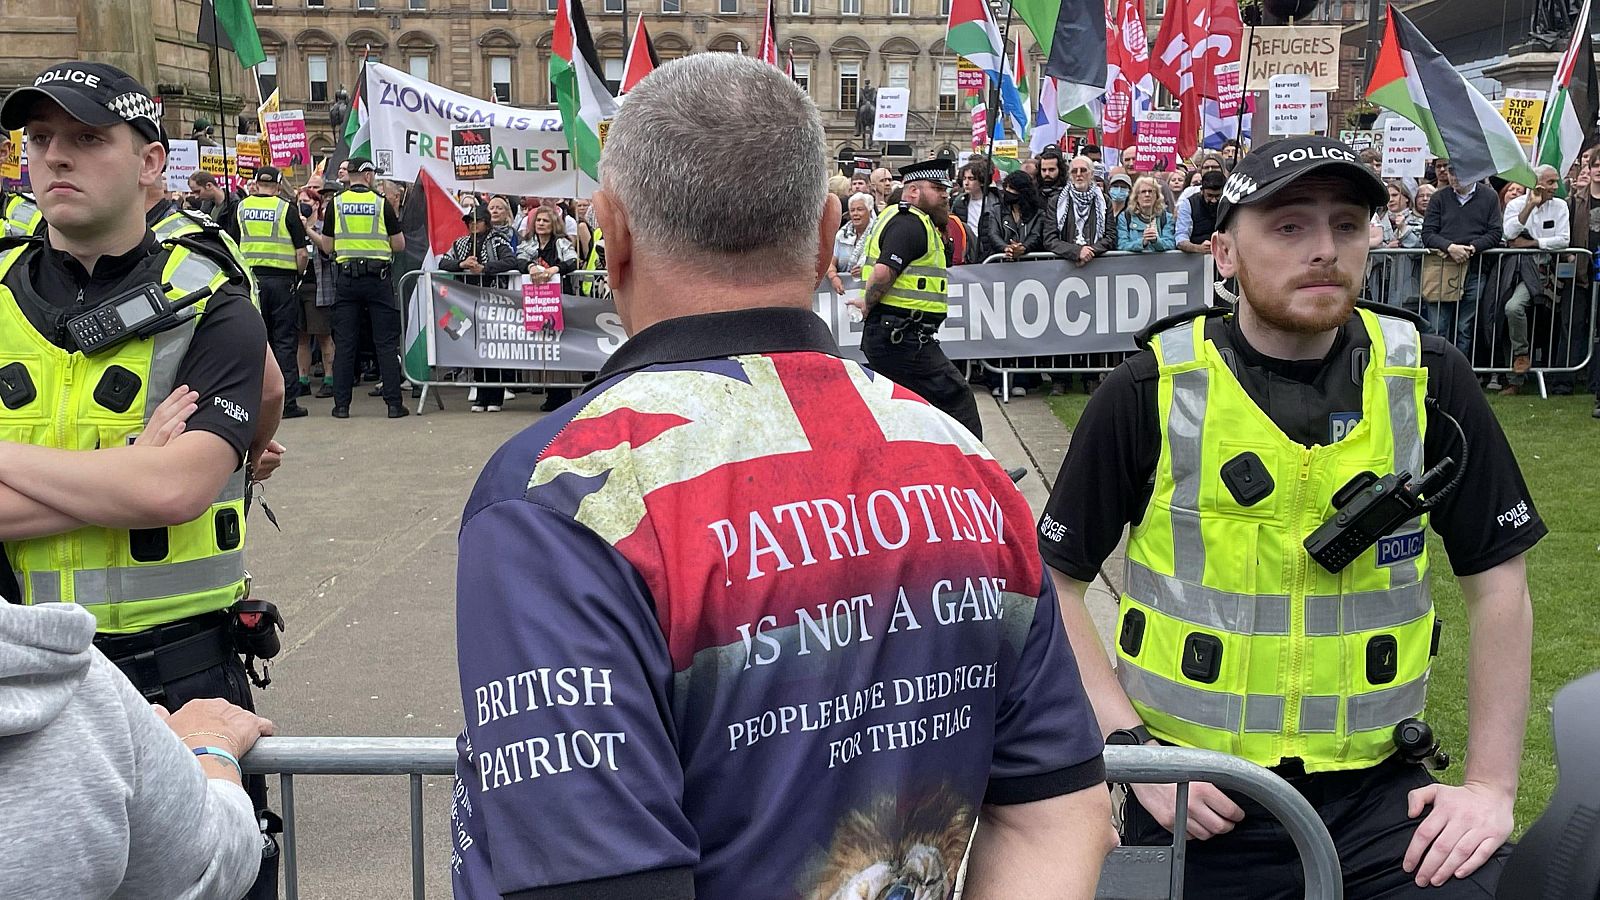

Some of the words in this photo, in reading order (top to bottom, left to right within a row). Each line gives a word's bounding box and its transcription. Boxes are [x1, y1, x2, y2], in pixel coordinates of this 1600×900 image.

[1252, 35, 1335, 56] REFUGEES
[1252, 60, 1328, 80] WELCOME
[34, 69, 101, 89] POLICE
[379, 79, 495, 127] ZIONISM
[1219, 101, 1238, 110] here
[1509, 99, 1535, 108] STOP
[1508, 108, 1526, 117] THE
[505, 115, 532, 131] IS
[1506, 117, 1523, 126] FAR
[269, 132, 306, 142] Refugees
[1511, 127, 1534, 136] IGHT
[271, 141, 305, 150] welcome
[405, 130, 453, 161] FRE
[1138, 134, 1177, 145] Refugees
[272, 150, 292, 159] here
[454, 144, 491, 155] REFUGEES
[1137, 144, 1174, 153] welcome
[202, 156, 235, 166] Refuges
[454, 154, 492, 166] WELCOME
[493, 146, 577, 172] ALEST
[1136, 152, 1156, 161] here
[1272, 146, 1356, 169] POLICE
[243, 209, 275, 221] POLICE
[343, 203, 376, 215] POLICE
[525, 295, 560, 305] Refugees
[939, 270, 1189, 342] ENOCIDE
[479, 306, 524, 323] GENOC
[525, 305, 559, 313] welcome
[525, 313, 544, 322] here
[479, 342, 561, 361] COMMITTEE
[708, 483, 1006, 587] PATRIOTISM
[1381, 533, 1425, 561] POLICE
[735, 615, 782, 671] IS
[794, 593, 874, 656] NOT
[887, 586, 922, 634] A
[892, 670, 952, 707] DIED
[953, 661, 998, 693] FIGH
[475, 666, 614, 727] BRITISH
[828, 730, 862, 769] FOR
[867, 718, 927, 753] THIS
[932, 704, 972, 742] FLAG
[479, 729, 626, 792] PATRIOT
